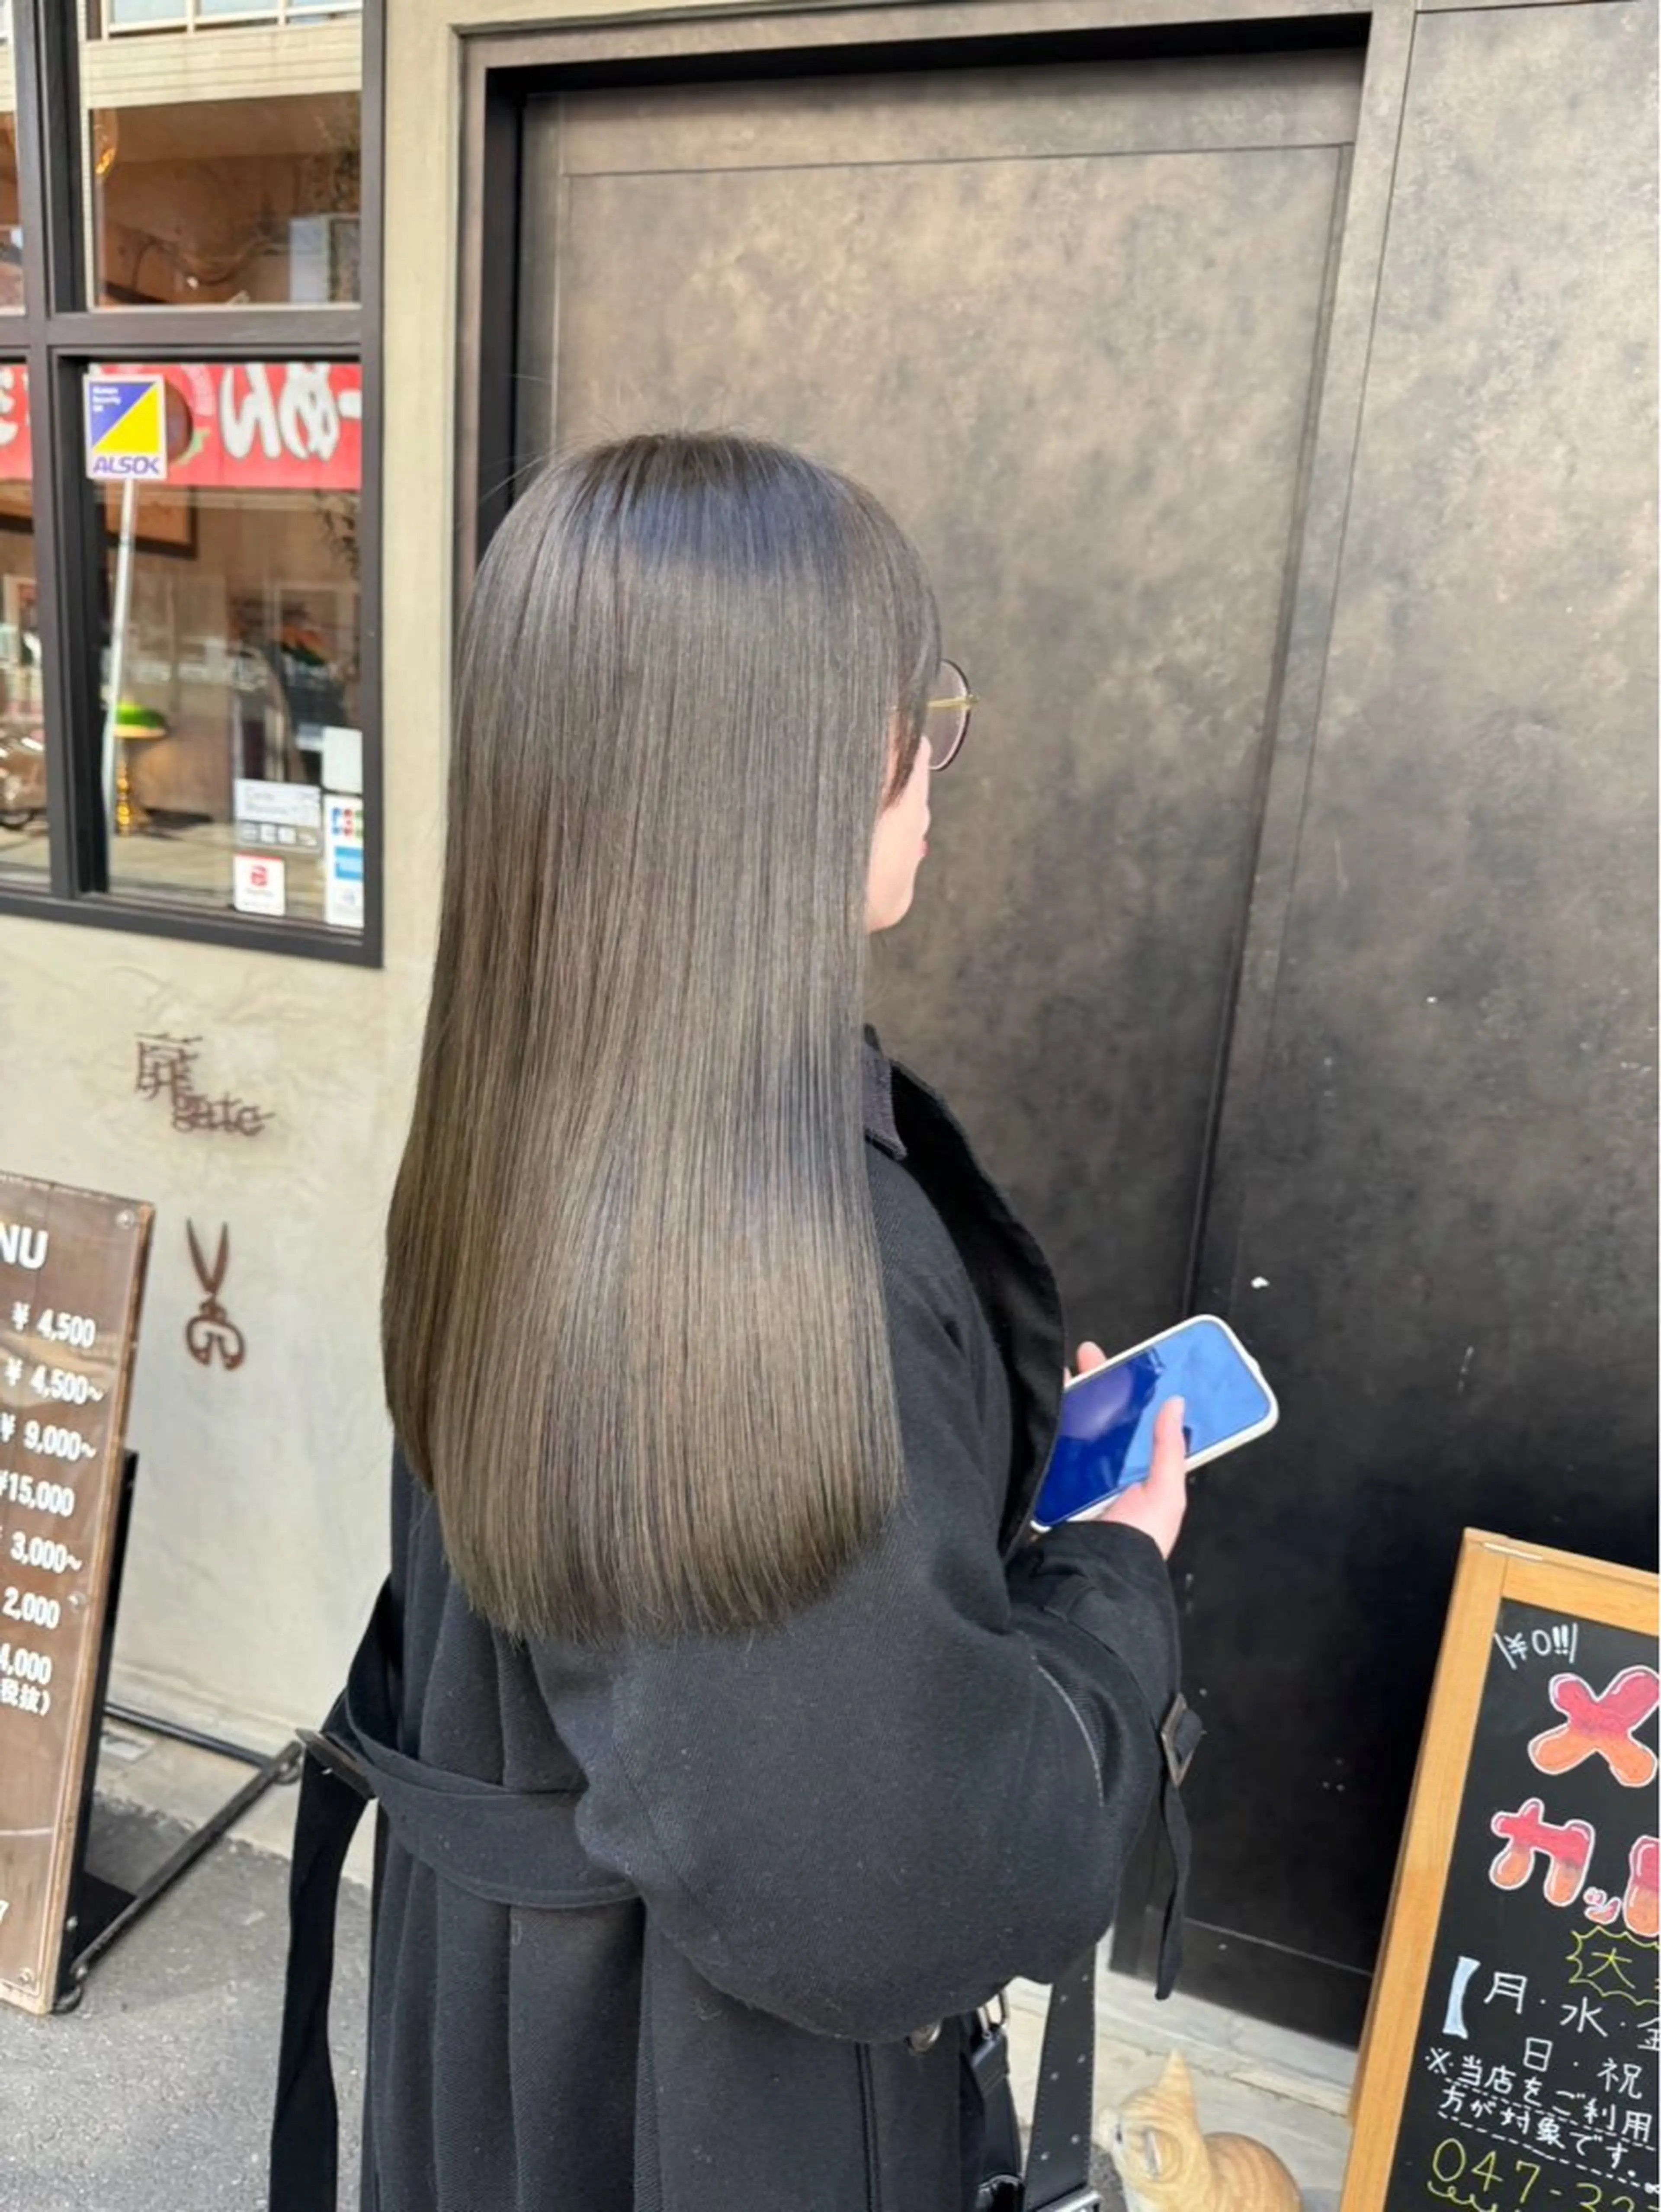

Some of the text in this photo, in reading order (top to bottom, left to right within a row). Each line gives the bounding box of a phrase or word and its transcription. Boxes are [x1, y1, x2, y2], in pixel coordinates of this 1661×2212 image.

[93, 455, 160, 475] ALSOK
[37, 1308, 96, 1348] 4,500
[3, 1586, 61, 1629] 2,000
